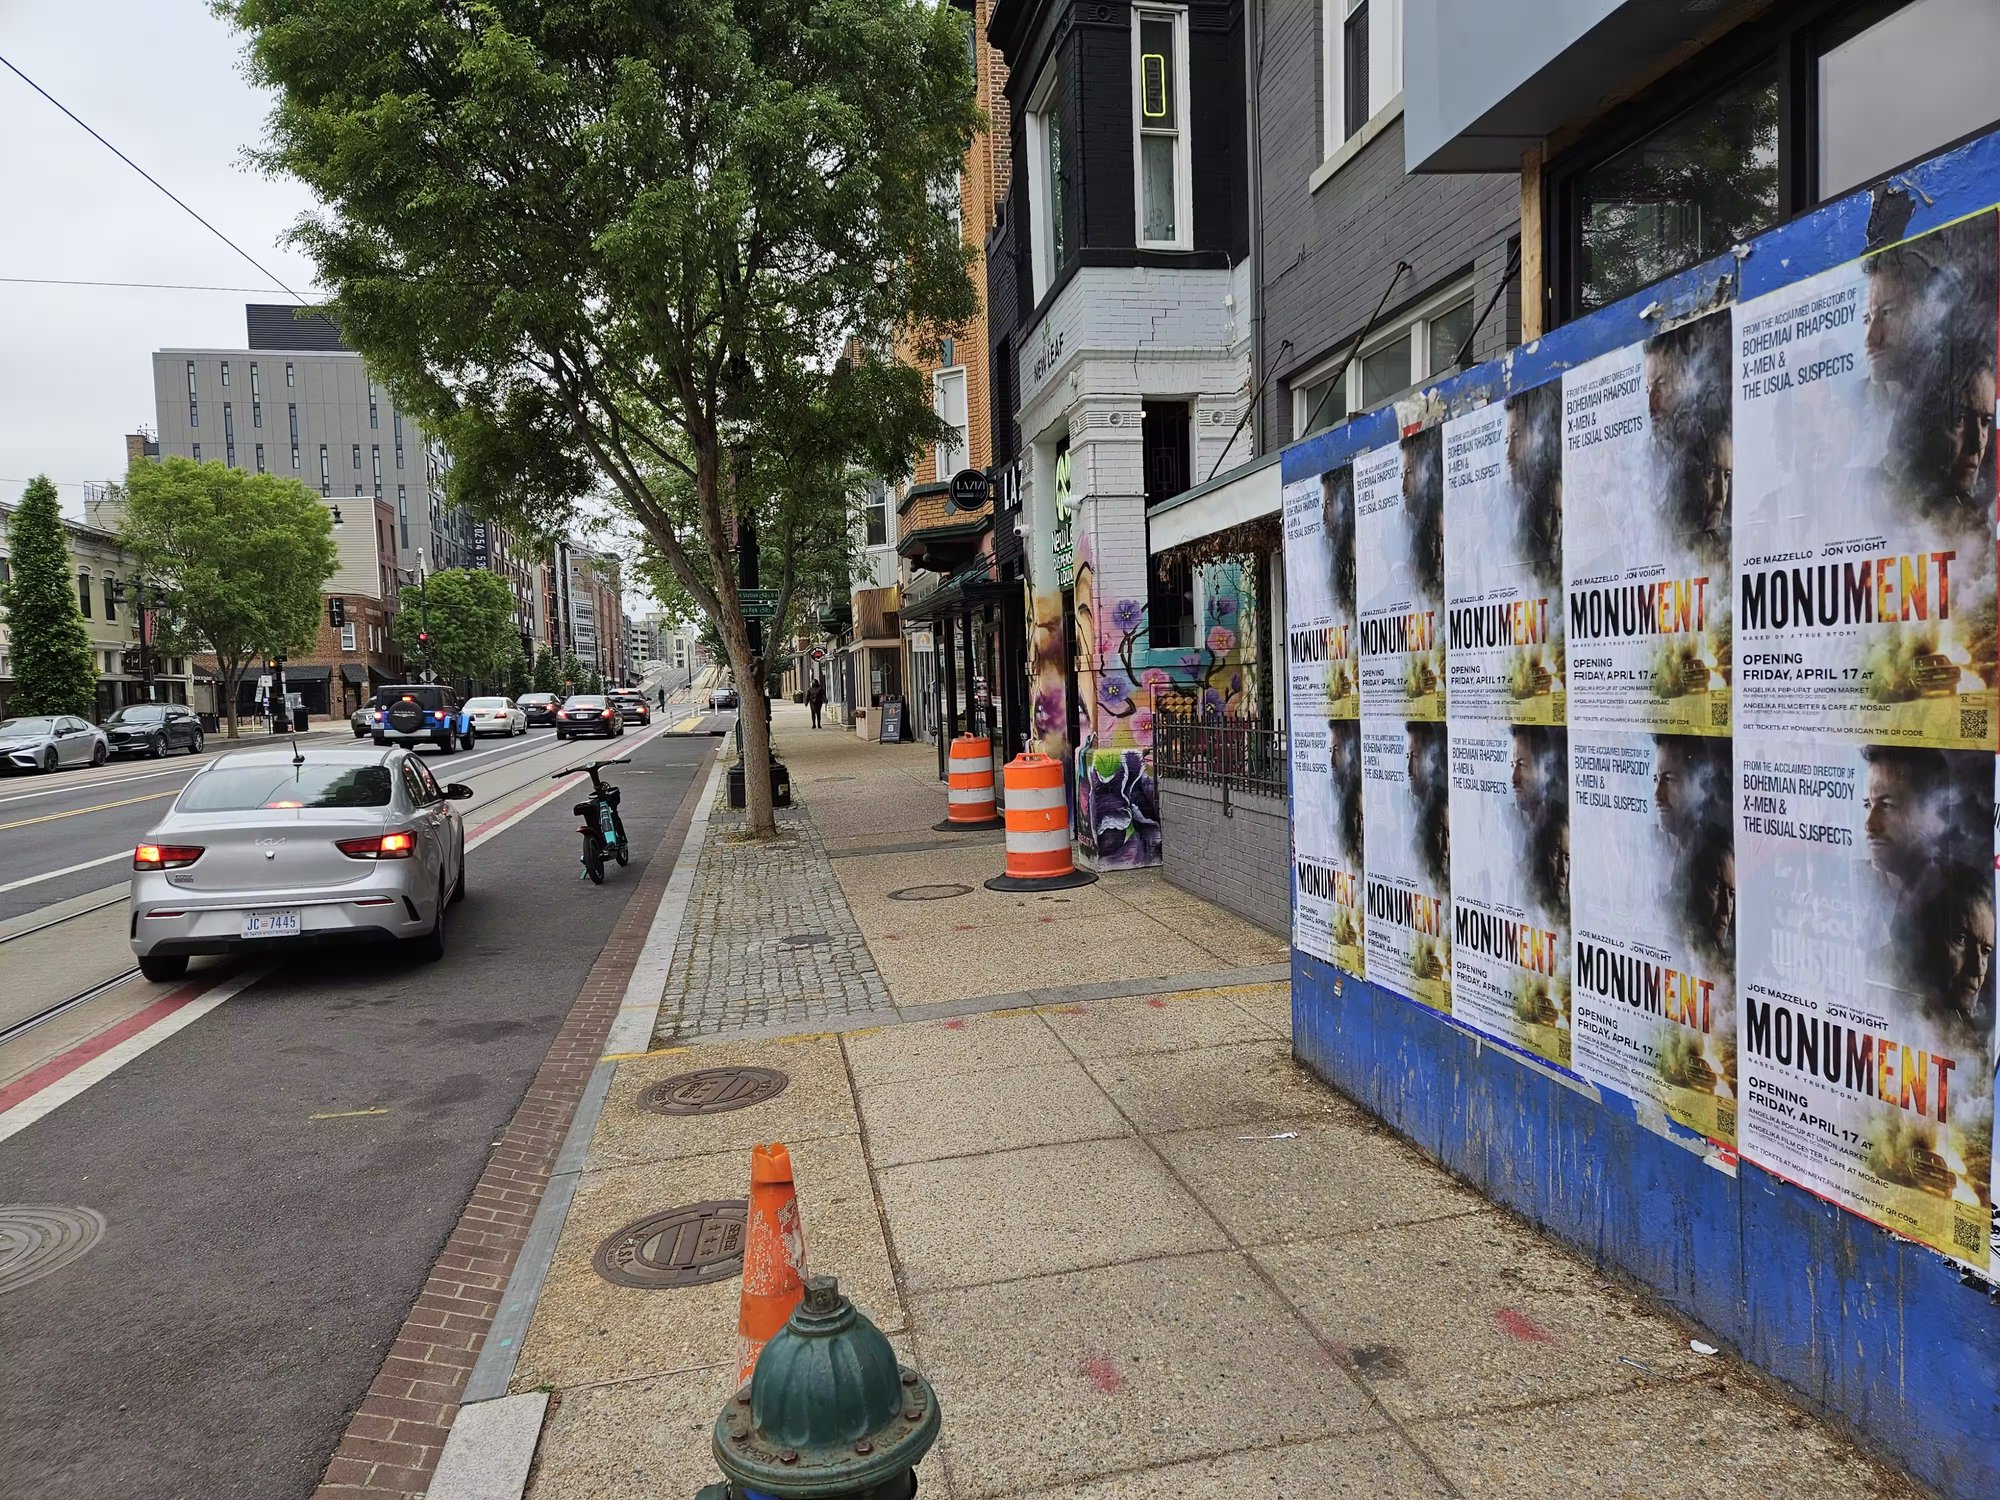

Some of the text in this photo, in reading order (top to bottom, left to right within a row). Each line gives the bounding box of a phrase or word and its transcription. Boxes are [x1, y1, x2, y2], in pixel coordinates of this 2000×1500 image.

[1743, 320, 1761, 336] FROM
[1762, 316, 1774, 330] THE
[1812, 292, 1846, 314] DIRECTOR
[1847, 288, 1857, 300] OF
[1796, 303, 1856, 339] RHAPSODY
[1033, 331, 1064, 384] NEW LEAF
[1742, 351, 1786, 380] X-MEN &
[1743, 382, 1761, 401] THE
[1798, 353, 1854, 385] SUSPECTS
[1566, 376, 1642, 415] BOHEMIAN RHAPSODY
[1568, 412, 1597, 433] X-MEN &
[1568, 416, 1643, 451] THE USUAL SUSPECTS
[1743, 540, 1888, 567] JOE MAZZELLO JON VOIGHT
[1584, 574, 1620, 585] MAZZELLO
[1639, 568, 1666, 578] VOIGHT
[1742, 551, 1956, 631] MONUMENT
[1450, 598, 1548, 650] MONUMENT
[1570, 576, 1710, 640] MONUMENT
[1290, 625, 1349, 664] MONUMENT
[1360, 611, 1434, 656] MONUMENT
[1450, 666, 1481, 674] OPENING
[1573, 658, 1612, 668] OPENING
[1743, 653, 1803, 666] OPENING
[1743, 668, 1875, 682] FRIDAY, APRIL 17 AT
[1574, 671, 1606, 682] FRIDAY,
[1608, 670, 1636, 680] APRIL
[1638, 670, 1648, 680] 17
[1574, 756, 1650, 776] BOHEMIAN RHAPSODY
[1743, 760, 1761, 772] FROM
[1774, 762, 1812, 776] ACCLAIMED
[1813, 765, 1846, 778] DIRECTOR
[1599, 777, 1606, 789] &
[1743, 774, 1856, 800] BOHEMIAN RHAPSODY
[1576, 791, 1648, 814] THE USUAL SUSPECTS
[1743, 795, 1787, 815] X-MEN &
[1743, 816, 1853, 847] THE USUAL SUSPECTS
[1298, 861, 1356, 908] MONUMENT
[248, 916, 296, 930] JC 7445
[1367, 881, 1442, 938] MONUMENT
[1455, 905, 1557, 978] MONUMENT
[1578, 930, 1590, 939] JOE
[1591, 933, 1625, 948] MAZZELLO
[1629, 944, 1644, 954] JON
[1456, 962, 1488, 979] OPENING
[1456, 971, 1512, 1001] FRIDAY, APRIL 17
[1577, 941, 1714, 1034] MONUMENT
[1578, 1006, 1618, 1030] OPENING
[1747, 984, 1889, 1032] JOE MAZZELLO JON VOIGHT
[1578, 1018, 1653, 1057] FRIDAY, APRIL 17
[1746, 998, 1956, 1124] MONUMENT
[1748, 1058, 1774, 1071] BASED
[1803, 1078, 1827, 1090] TRUE
[1748, 1076, 1808, 1108] OPENING
[1748, 1091, 1798, 1120] FRIDAY,
[1800, 1108, 1838, 1137] APRIL
[1842, 1130, 1859, 1145] 17
[1861, 1140, 1874, 1151] AT
[1748, 1107, 1870, 1164] ANGELIKA POP-UP AT UNION MARKET
[1748, 1123, 1780, 1140] ANGELIKA
[1781, 1136, 1796, 1148] FILM
[1796, 1143, 1822, 1160] CENTER
[1846, 1166, 1856, 1176] AT
[1858, 1171, 1890, 1190] MOSAIC
[1748, 1142, 1758, 1152] GET
[1760, 1146, 1783, 1162] TICKETS
[1850, 1191, 1871, 1204] SCAN
[1871, 1199, 1885, 1212] THE
[1886, 1206, 1896, 1216] QR
[1897, 1212, 1918, 1227] CODE
